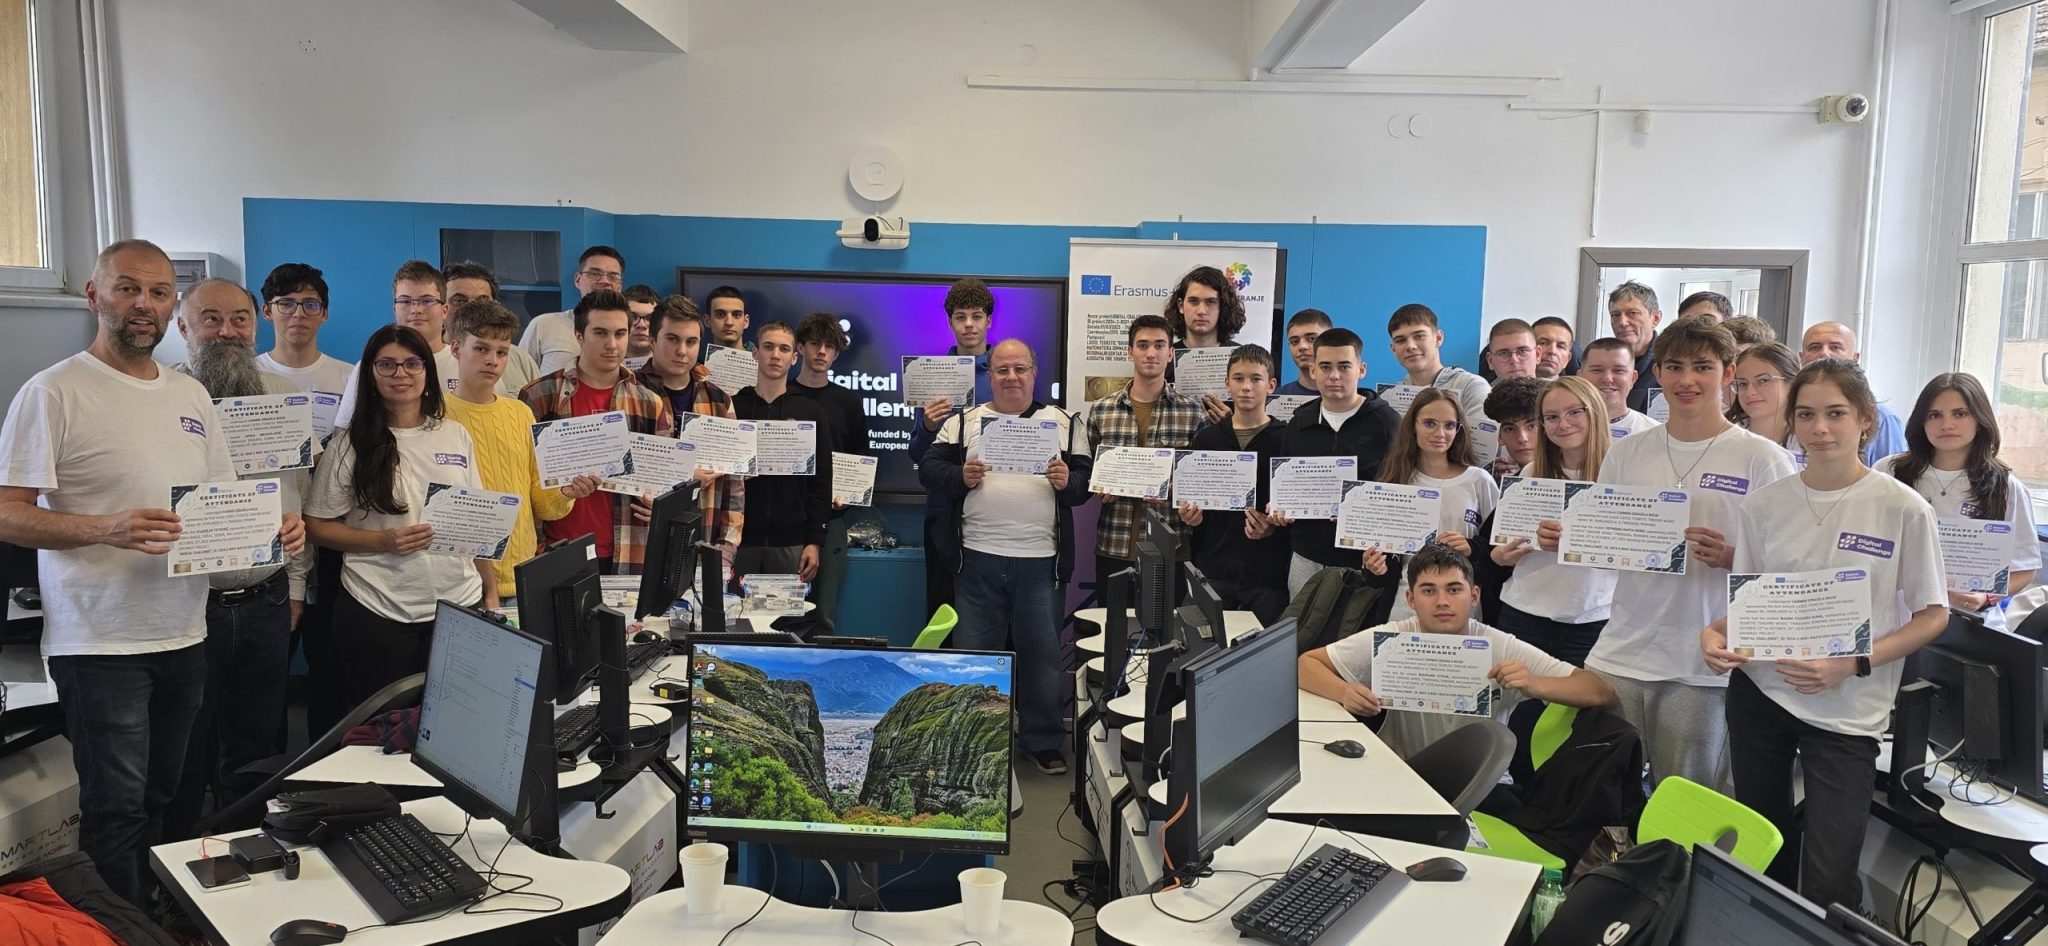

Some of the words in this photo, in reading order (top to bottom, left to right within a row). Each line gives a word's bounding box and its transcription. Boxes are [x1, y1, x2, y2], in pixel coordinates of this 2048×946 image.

[827, 369, 897, 391] igital
[868, 429, 900, 439] funded
[902, 430, 911, 441] by
[1716, 483, 1746, 493] Challenge
[1858, 538, 1882, 548] Digital
[1857, 545, 1891, 556] Challenge
